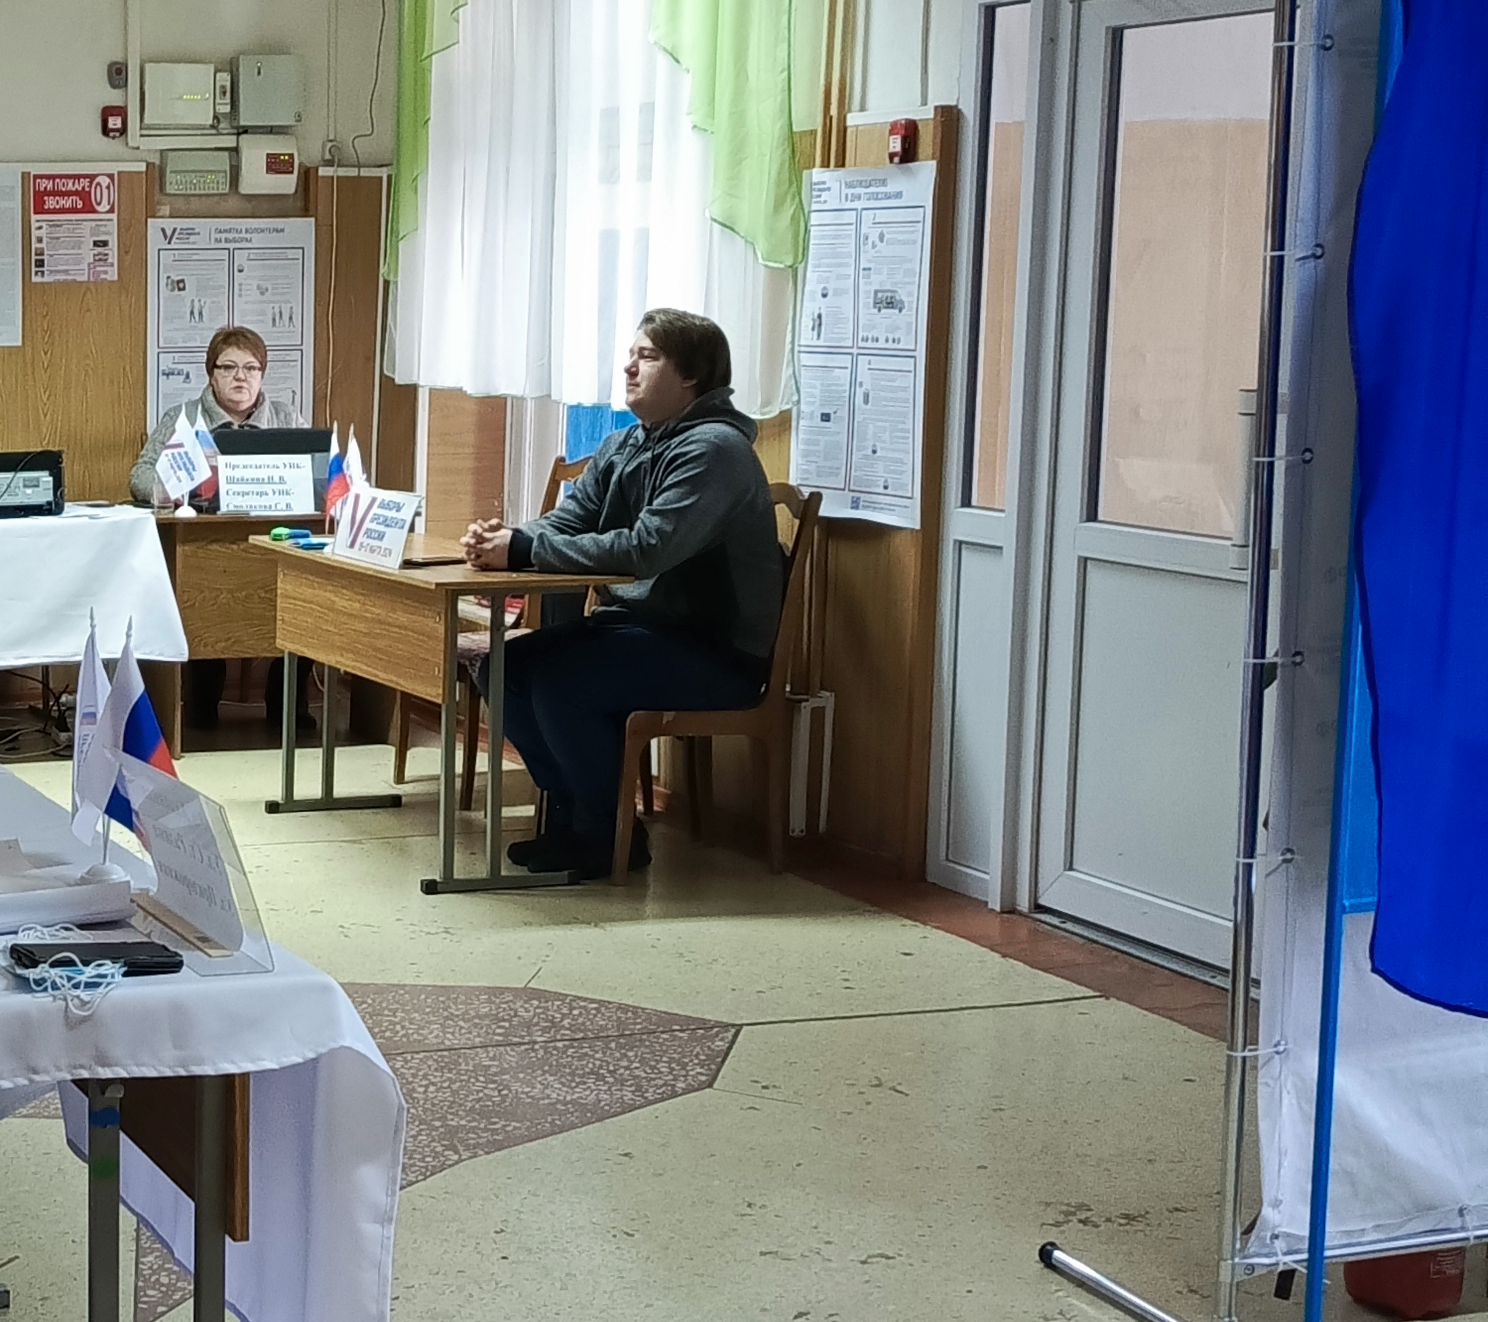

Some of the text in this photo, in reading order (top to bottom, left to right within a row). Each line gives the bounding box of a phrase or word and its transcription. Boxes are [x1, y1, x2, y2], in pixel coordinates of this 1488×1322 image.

[35, 178, 90, 191] ПРИ ПОЖАРЕ
[94, 181, 111, 206] 01
[43, 196, 83, 209] ЗВОНИТЬ
[214, 227, 243, 235] ПАМЯТКА
